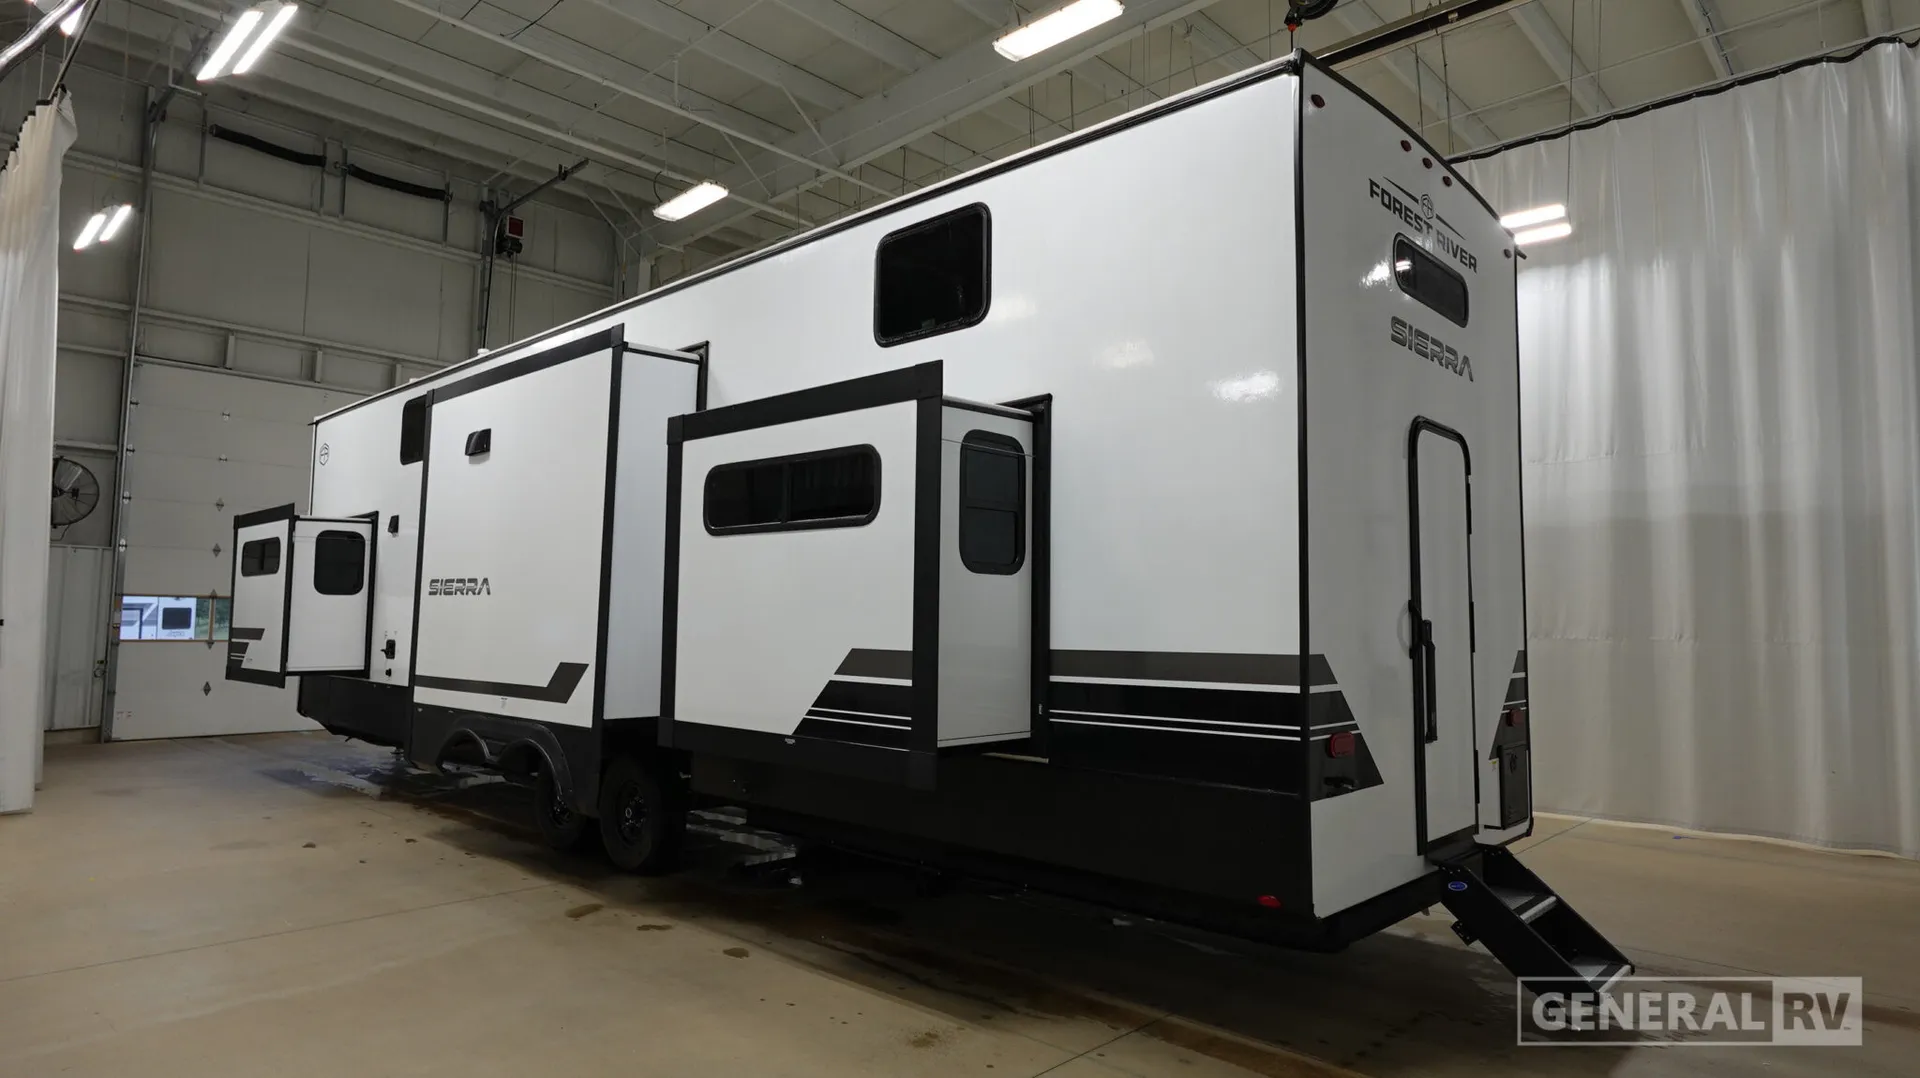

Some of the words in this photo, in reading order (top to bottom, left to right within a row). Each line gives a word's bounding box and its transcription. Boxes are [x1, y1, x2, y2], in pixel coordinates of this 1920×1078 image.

[1368, 178, 1433, 236] FOREST
[1436, 226, 1478, 274] RIVER
[1390, 315, 1474, 383] SIERRA
[428, 577, 491, 596] SIERRA
